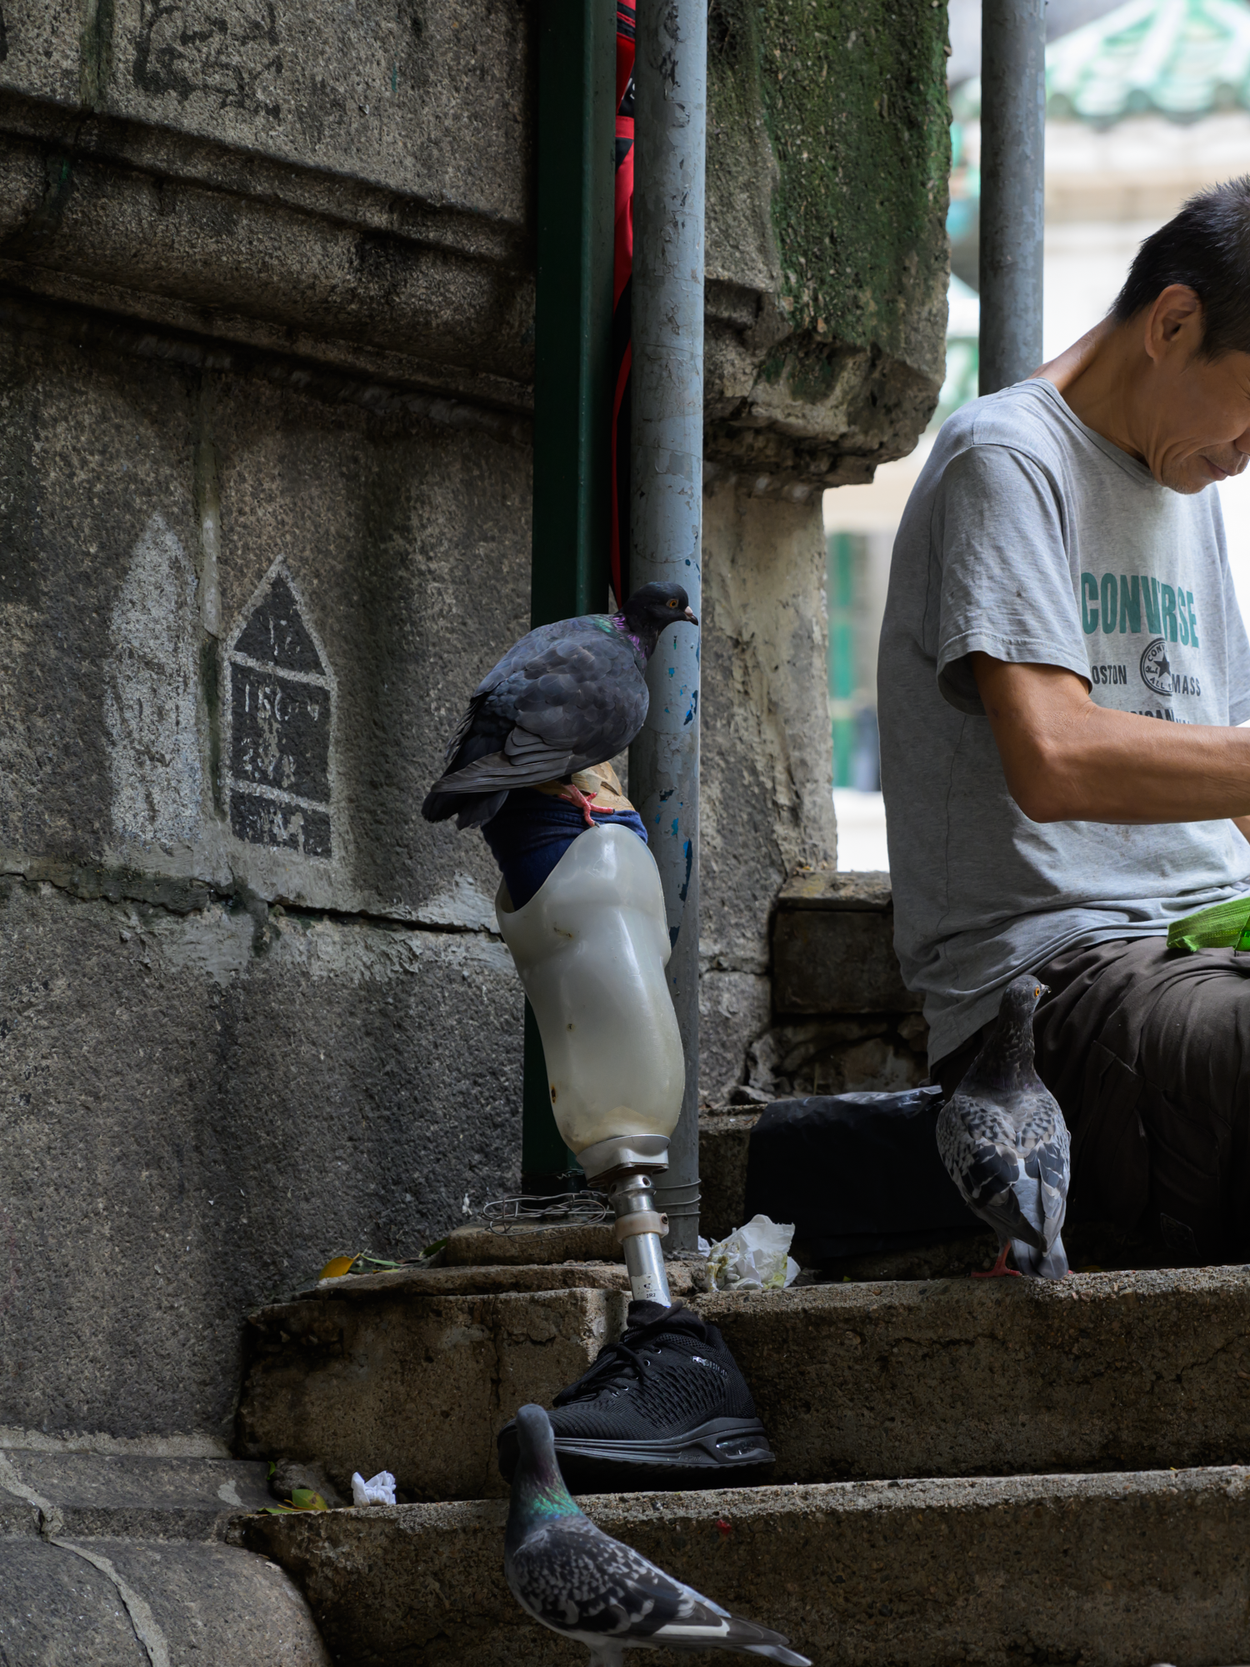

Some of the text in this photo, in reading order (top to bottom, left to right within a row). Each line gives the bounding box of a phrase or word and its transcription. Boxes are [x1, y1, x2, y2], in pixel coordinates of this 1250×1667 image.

[1081, 572, 1199, 648] CONVRSE
[1090, 664, 1201, 697] OSTON MASS
[1150, 677, 1165, 690] ALL
